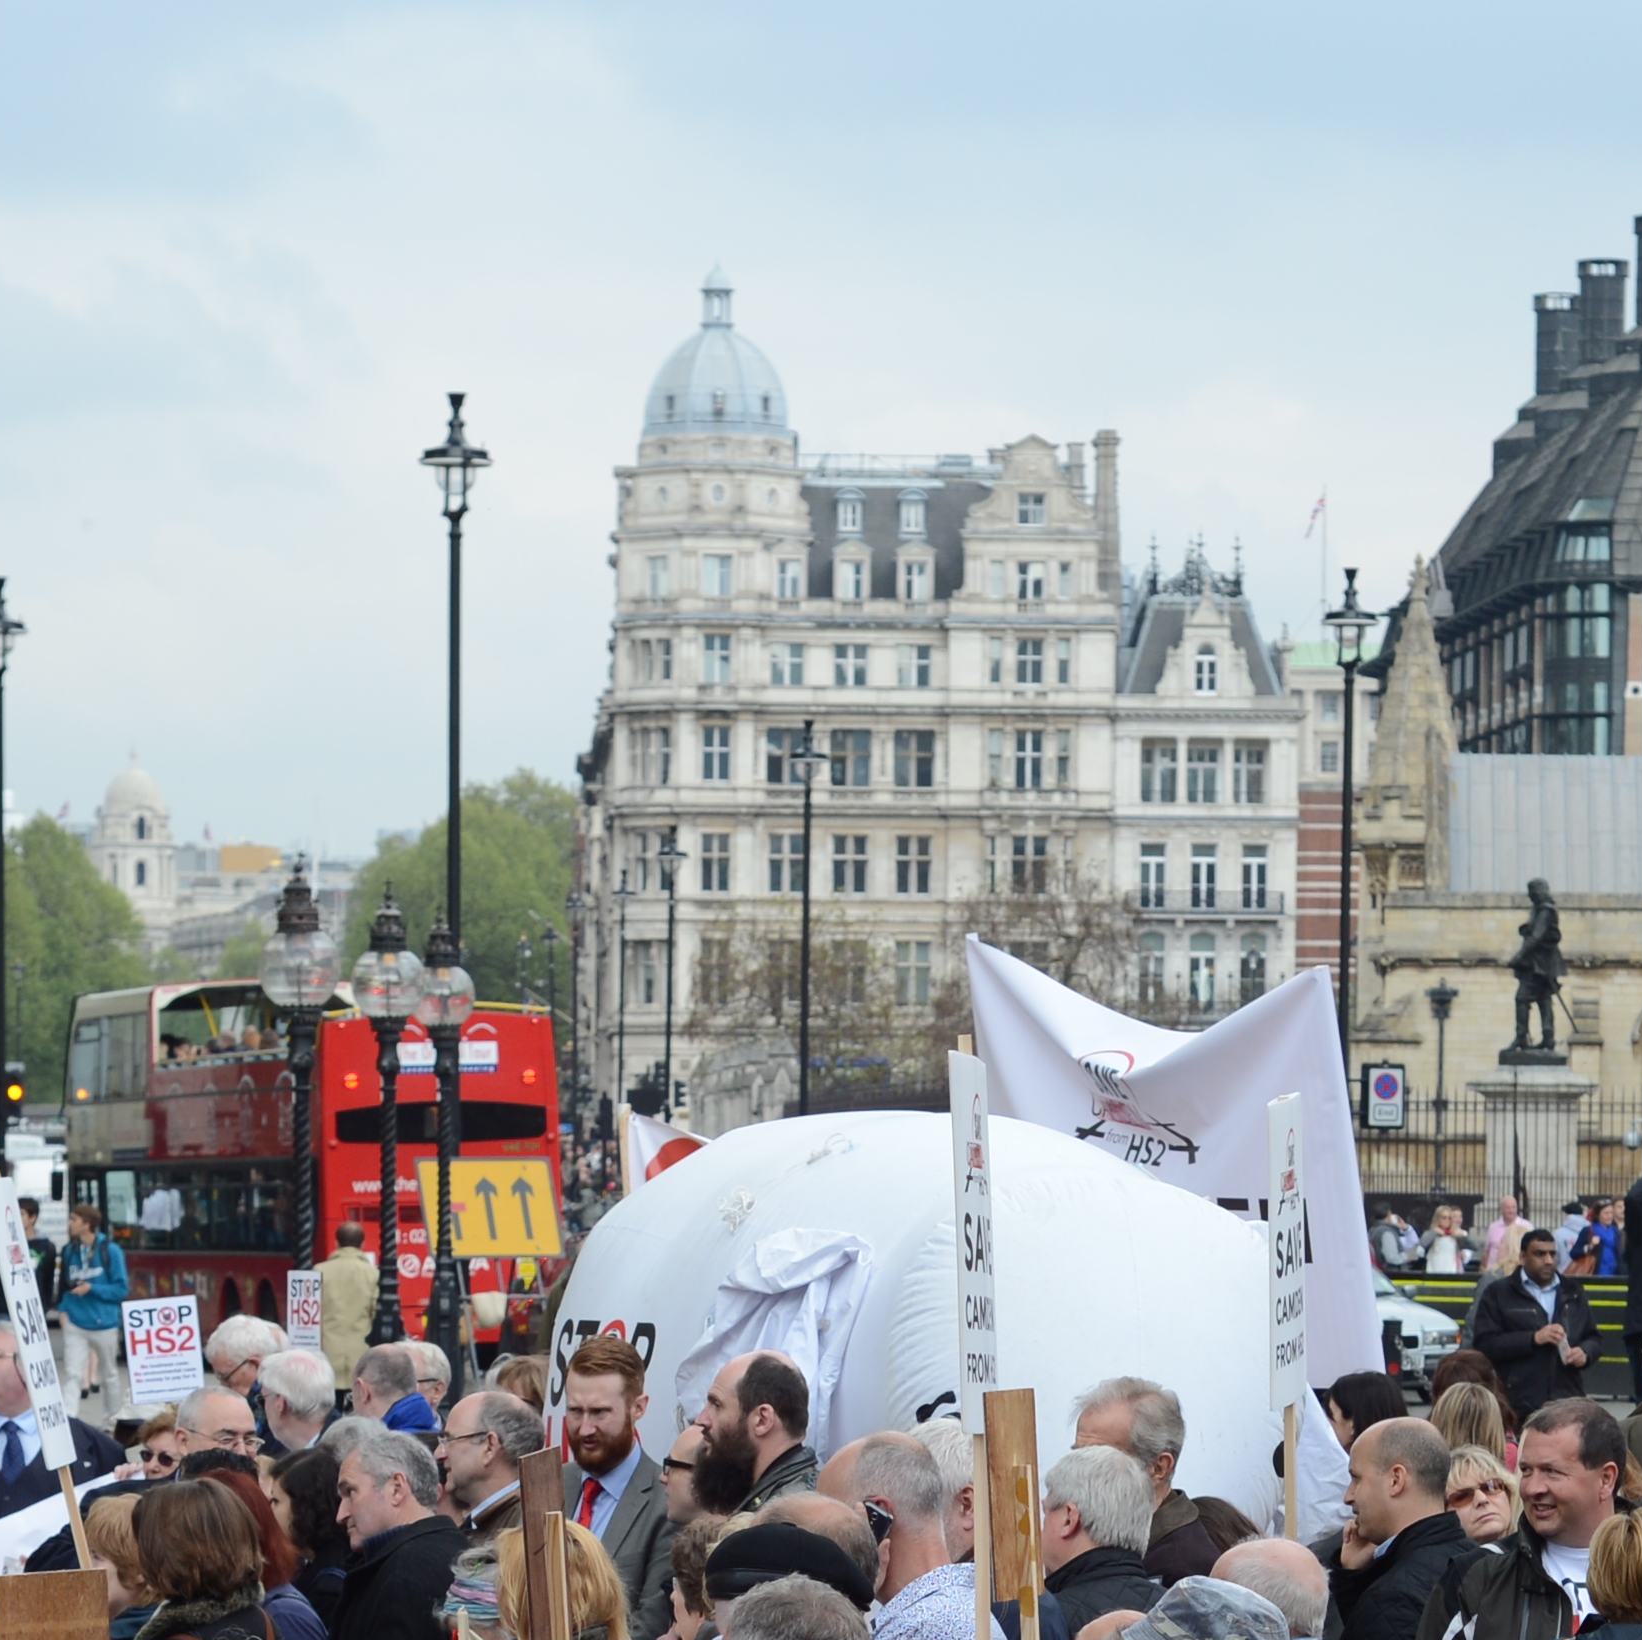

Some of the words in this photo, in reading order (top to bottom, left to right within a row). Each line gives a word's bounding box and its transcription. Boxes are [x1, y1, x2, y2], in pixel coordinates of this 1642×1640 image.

[1105, 1127, 1129, 1146] from
[1124, 1133, 1167, 1167] HS2
[290, 1278, 320, 1298] STOP
[128, 1305, 192, 1329] STOP
[290, 1299, 320, 1326] HS2
[129, 1325, 196, 1356] HS2
